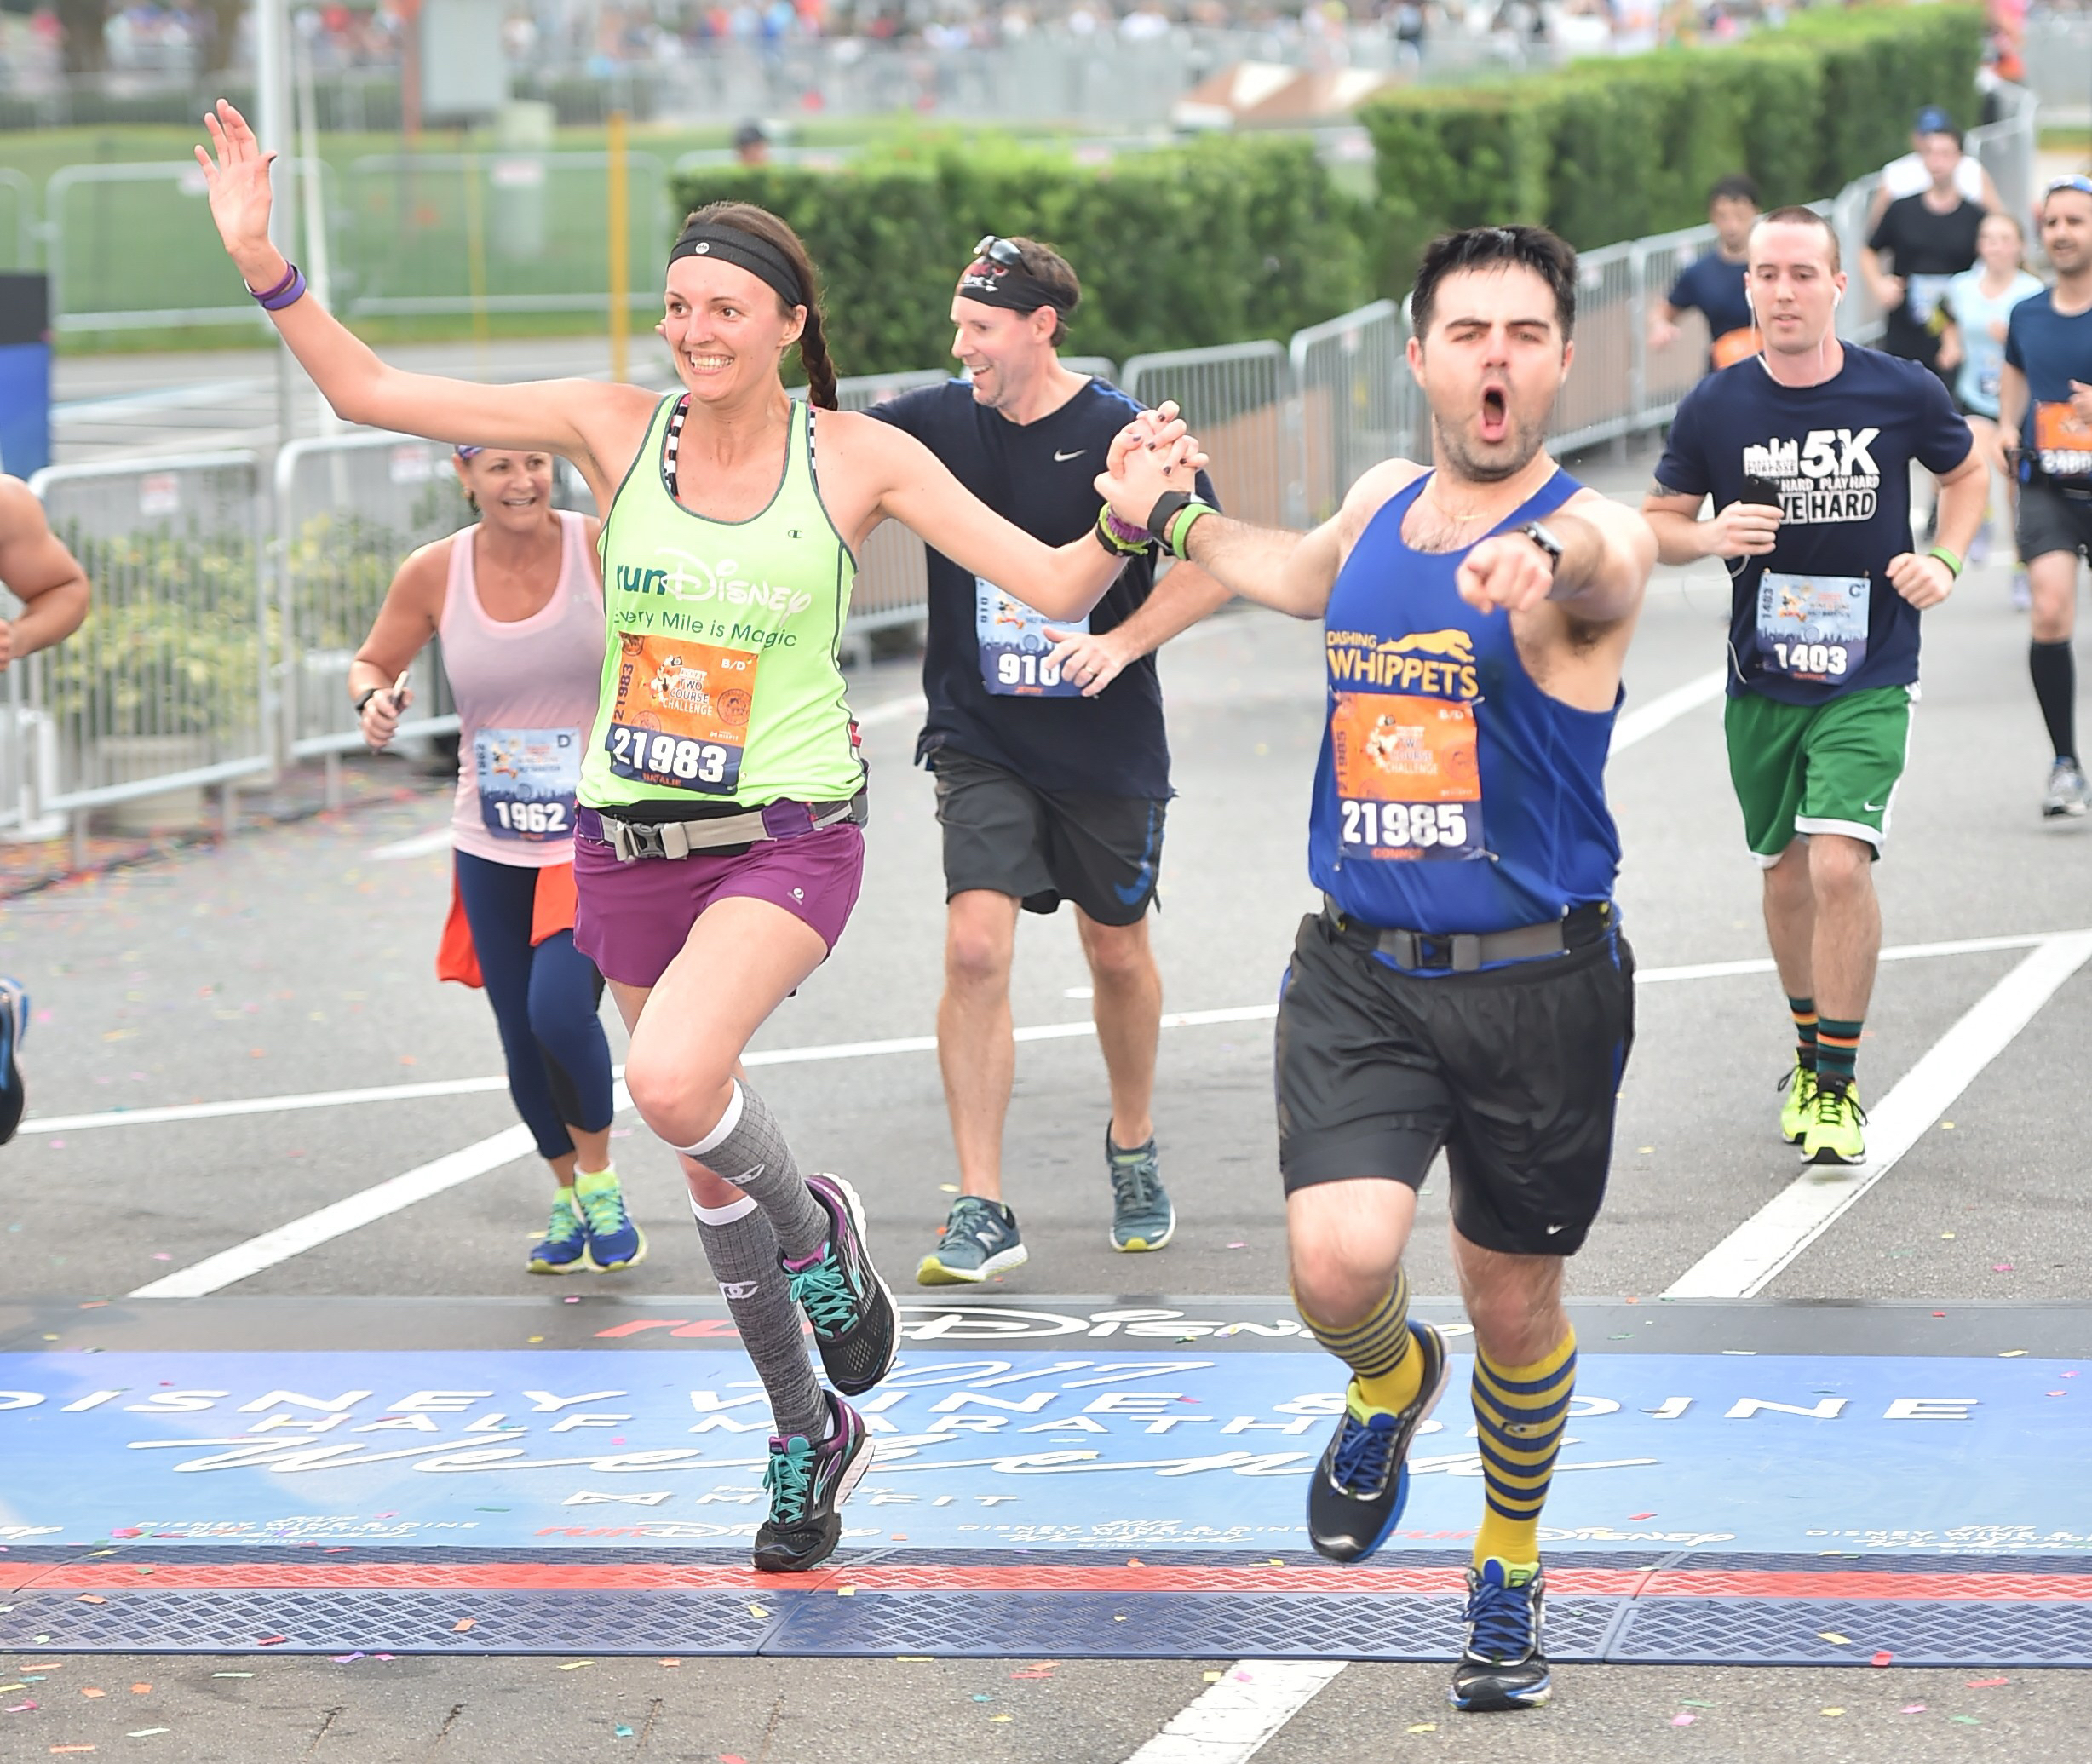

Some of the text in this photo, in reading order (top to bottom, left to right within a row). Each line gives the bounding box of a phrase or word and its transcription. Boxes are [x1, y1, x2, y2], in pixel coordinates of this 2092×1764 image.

[1800, 428, 1881, 478] 5K
[1780, 474, 1880, 492] HARD PLAY HARD
[1810, 491, 1875, 520] HARD
[662, 611, 704, 635] Mile
[710, 618, 725, 638] is
[731, 623, 798, 651] Magic
[1326, 629, 1377, 649] DASHING
[721, 658, 746, 671] B/D
[1773, 643, 1848, 675] 1403
[680, 679, 703, 691] TWO
[1327, 648, 1480, 698] WHIPPETS
[613, 663, 634, 721] 21983
[670, 687, 710, 704] COURSE
[662, 698, 714, 716] CHALLENGE
[557, 734, 572, 748] D
[613, 727, 727, 784] 21983
[1384, 762, 1439, 775] CHALLENGE
[494, 801, 569, 833] 1962
[1341, 800, 1468, 848] 21985
[247, 1414, 633, 1433] HALF
